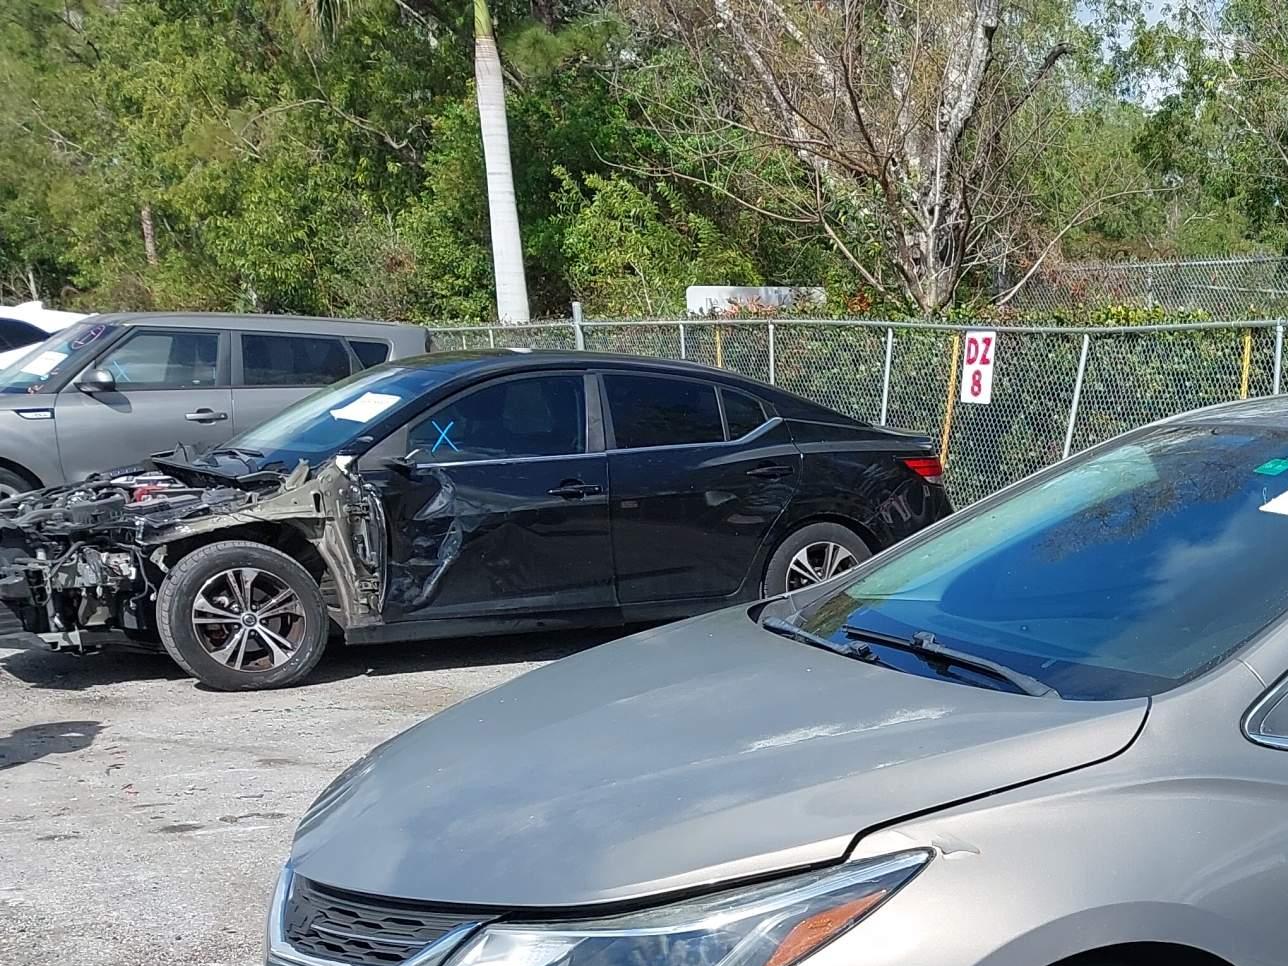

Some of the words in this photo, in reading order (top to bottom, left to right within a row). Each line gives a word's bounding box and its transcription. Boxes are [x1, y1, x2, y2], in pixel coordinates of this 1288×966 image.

[965, 336, 993, 366] DZ
[970, 369, 982, 397] 8
[431, 420, 460, 453] X
